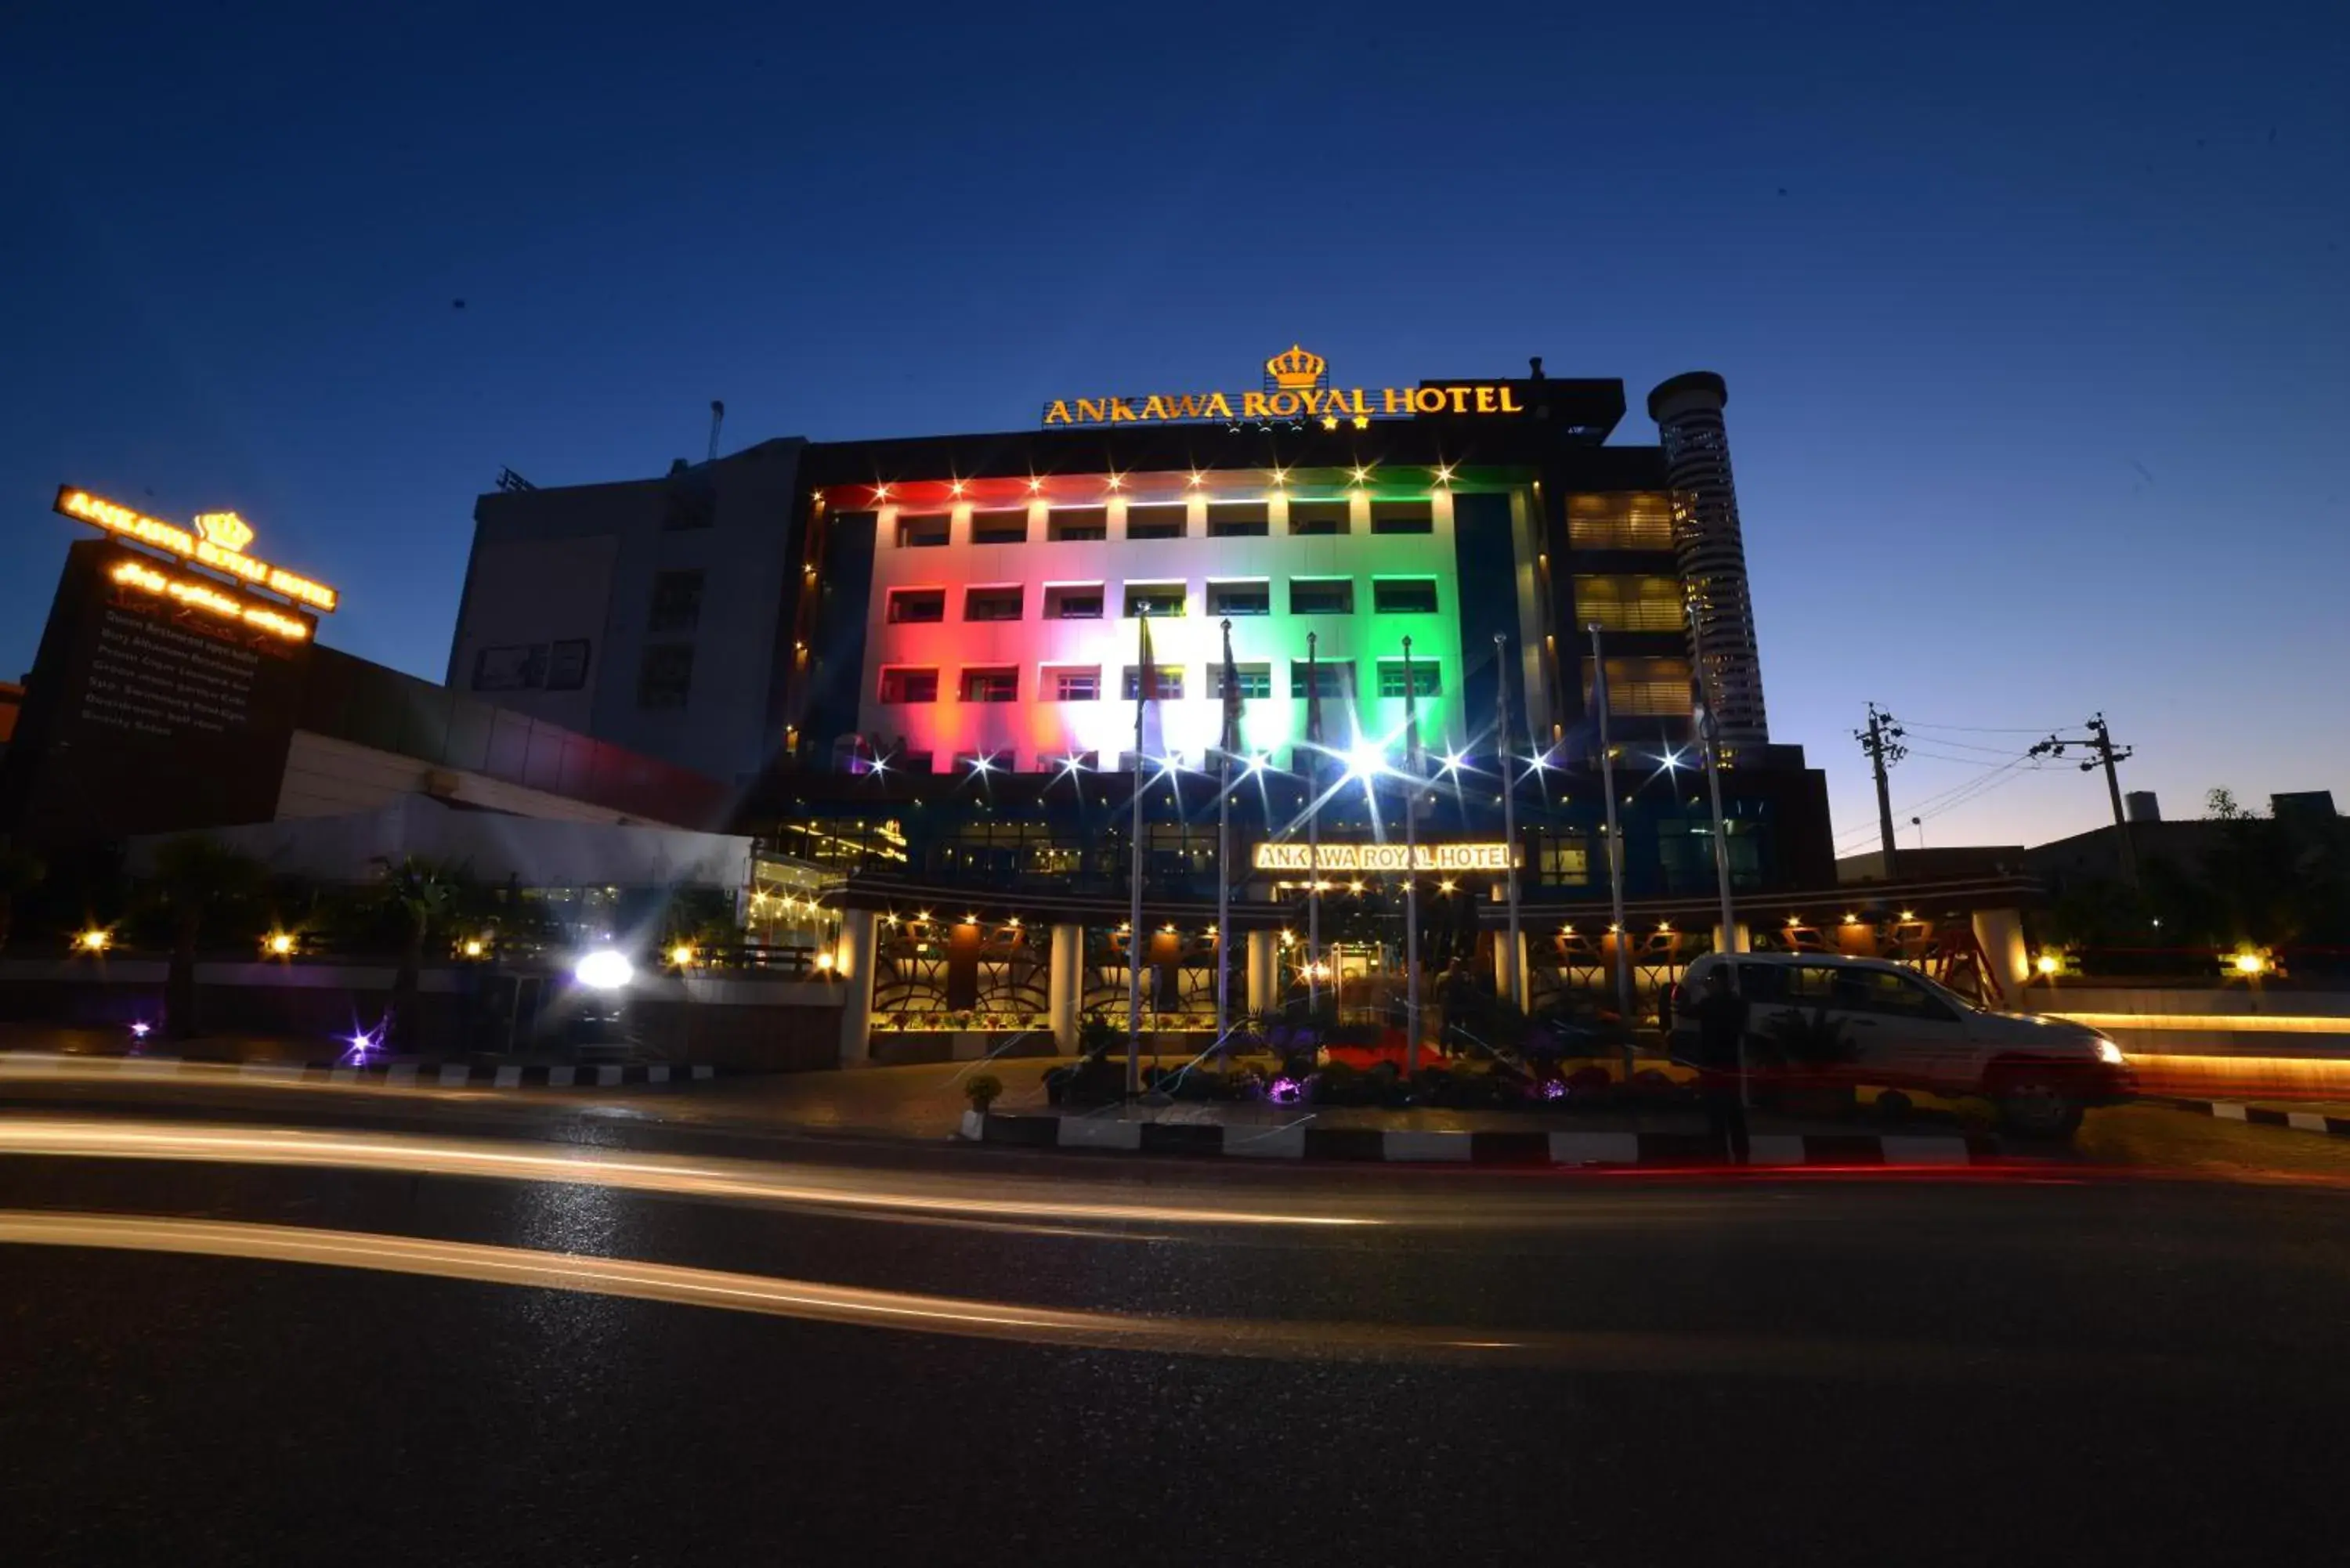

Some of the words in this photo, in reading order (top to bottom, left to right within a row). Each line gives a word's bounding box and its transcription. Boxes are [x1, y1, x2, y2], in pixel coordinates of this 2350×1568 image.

[1045, 392, 1234, 424] ANKAWA
[1242, 388, 1375, 417] ROYAL
[1384, 387, 1524, 414] HOTEL
[1261, 848, 1356, 866] ANKAWA
[1363, 848, 1434, 866] ROYAL
[1441, 847, 1510, 865] HOTEL
